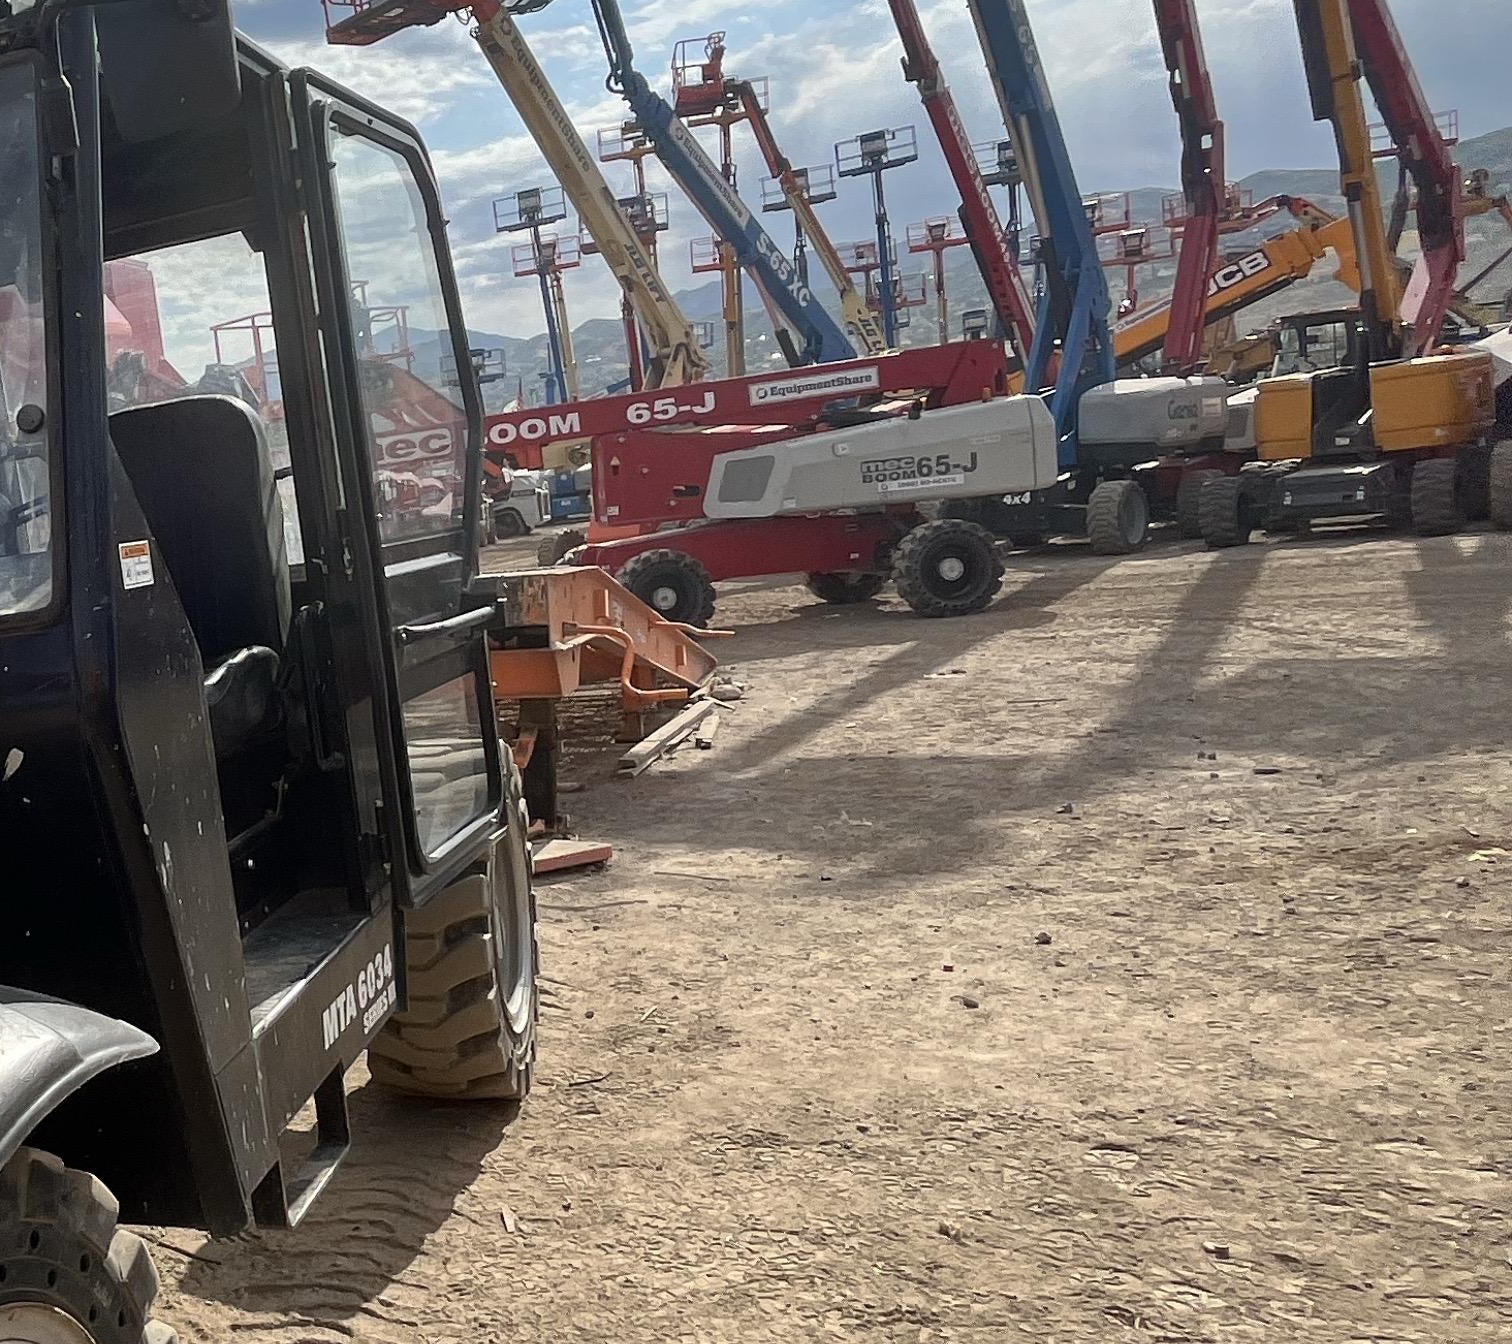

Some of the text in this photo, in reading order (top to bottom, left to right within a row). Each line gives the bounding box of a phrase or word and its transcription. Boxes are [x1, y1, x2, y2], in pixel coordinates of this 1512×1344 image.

[786, 268, 811, 307] XC
[770, 374, 872, 397] EquipmentShare
[465, 412, 581, 446] OOM
[626, 391, 716, 425] 65-J
[860, 456, 916, 473] mec
[862, 470, 917, 484] BOOM
[916, 451, 978, 478] 65-J
[1002, 491, 1032, 505] 4x4
[322, 943, 393, 1051] MTA 6034
